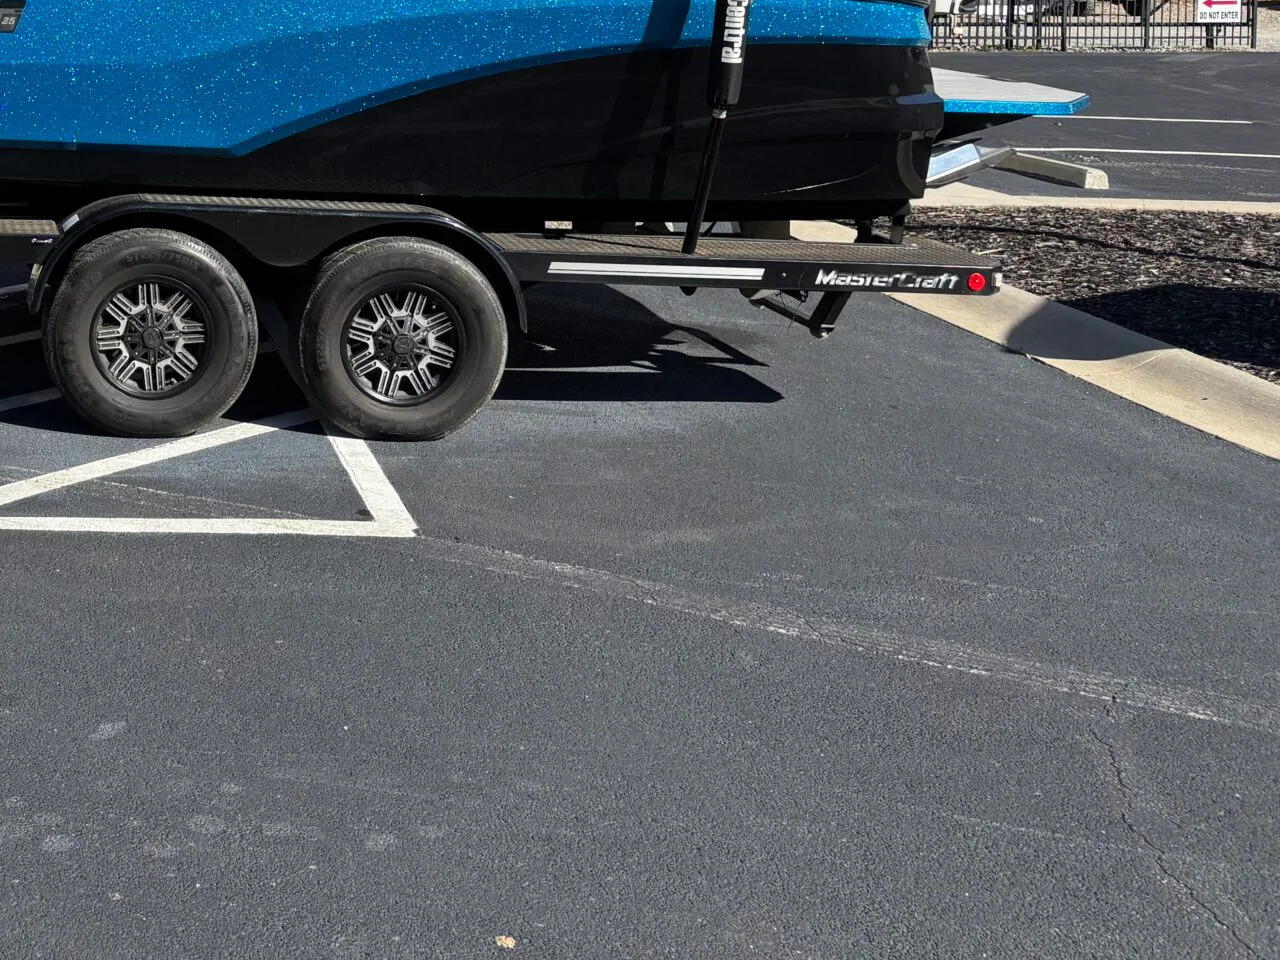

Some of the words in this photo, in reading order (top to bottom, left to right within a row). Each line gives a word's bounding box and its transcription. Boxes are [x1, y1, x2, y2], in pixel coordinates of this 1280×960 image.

[1200, 12, 1208, 20] DO
[1208, 12, 1220, 20] NOT
[1220, 11, 1239, 20] ENTER
[815, 267, 961, 290] MasterCraft
